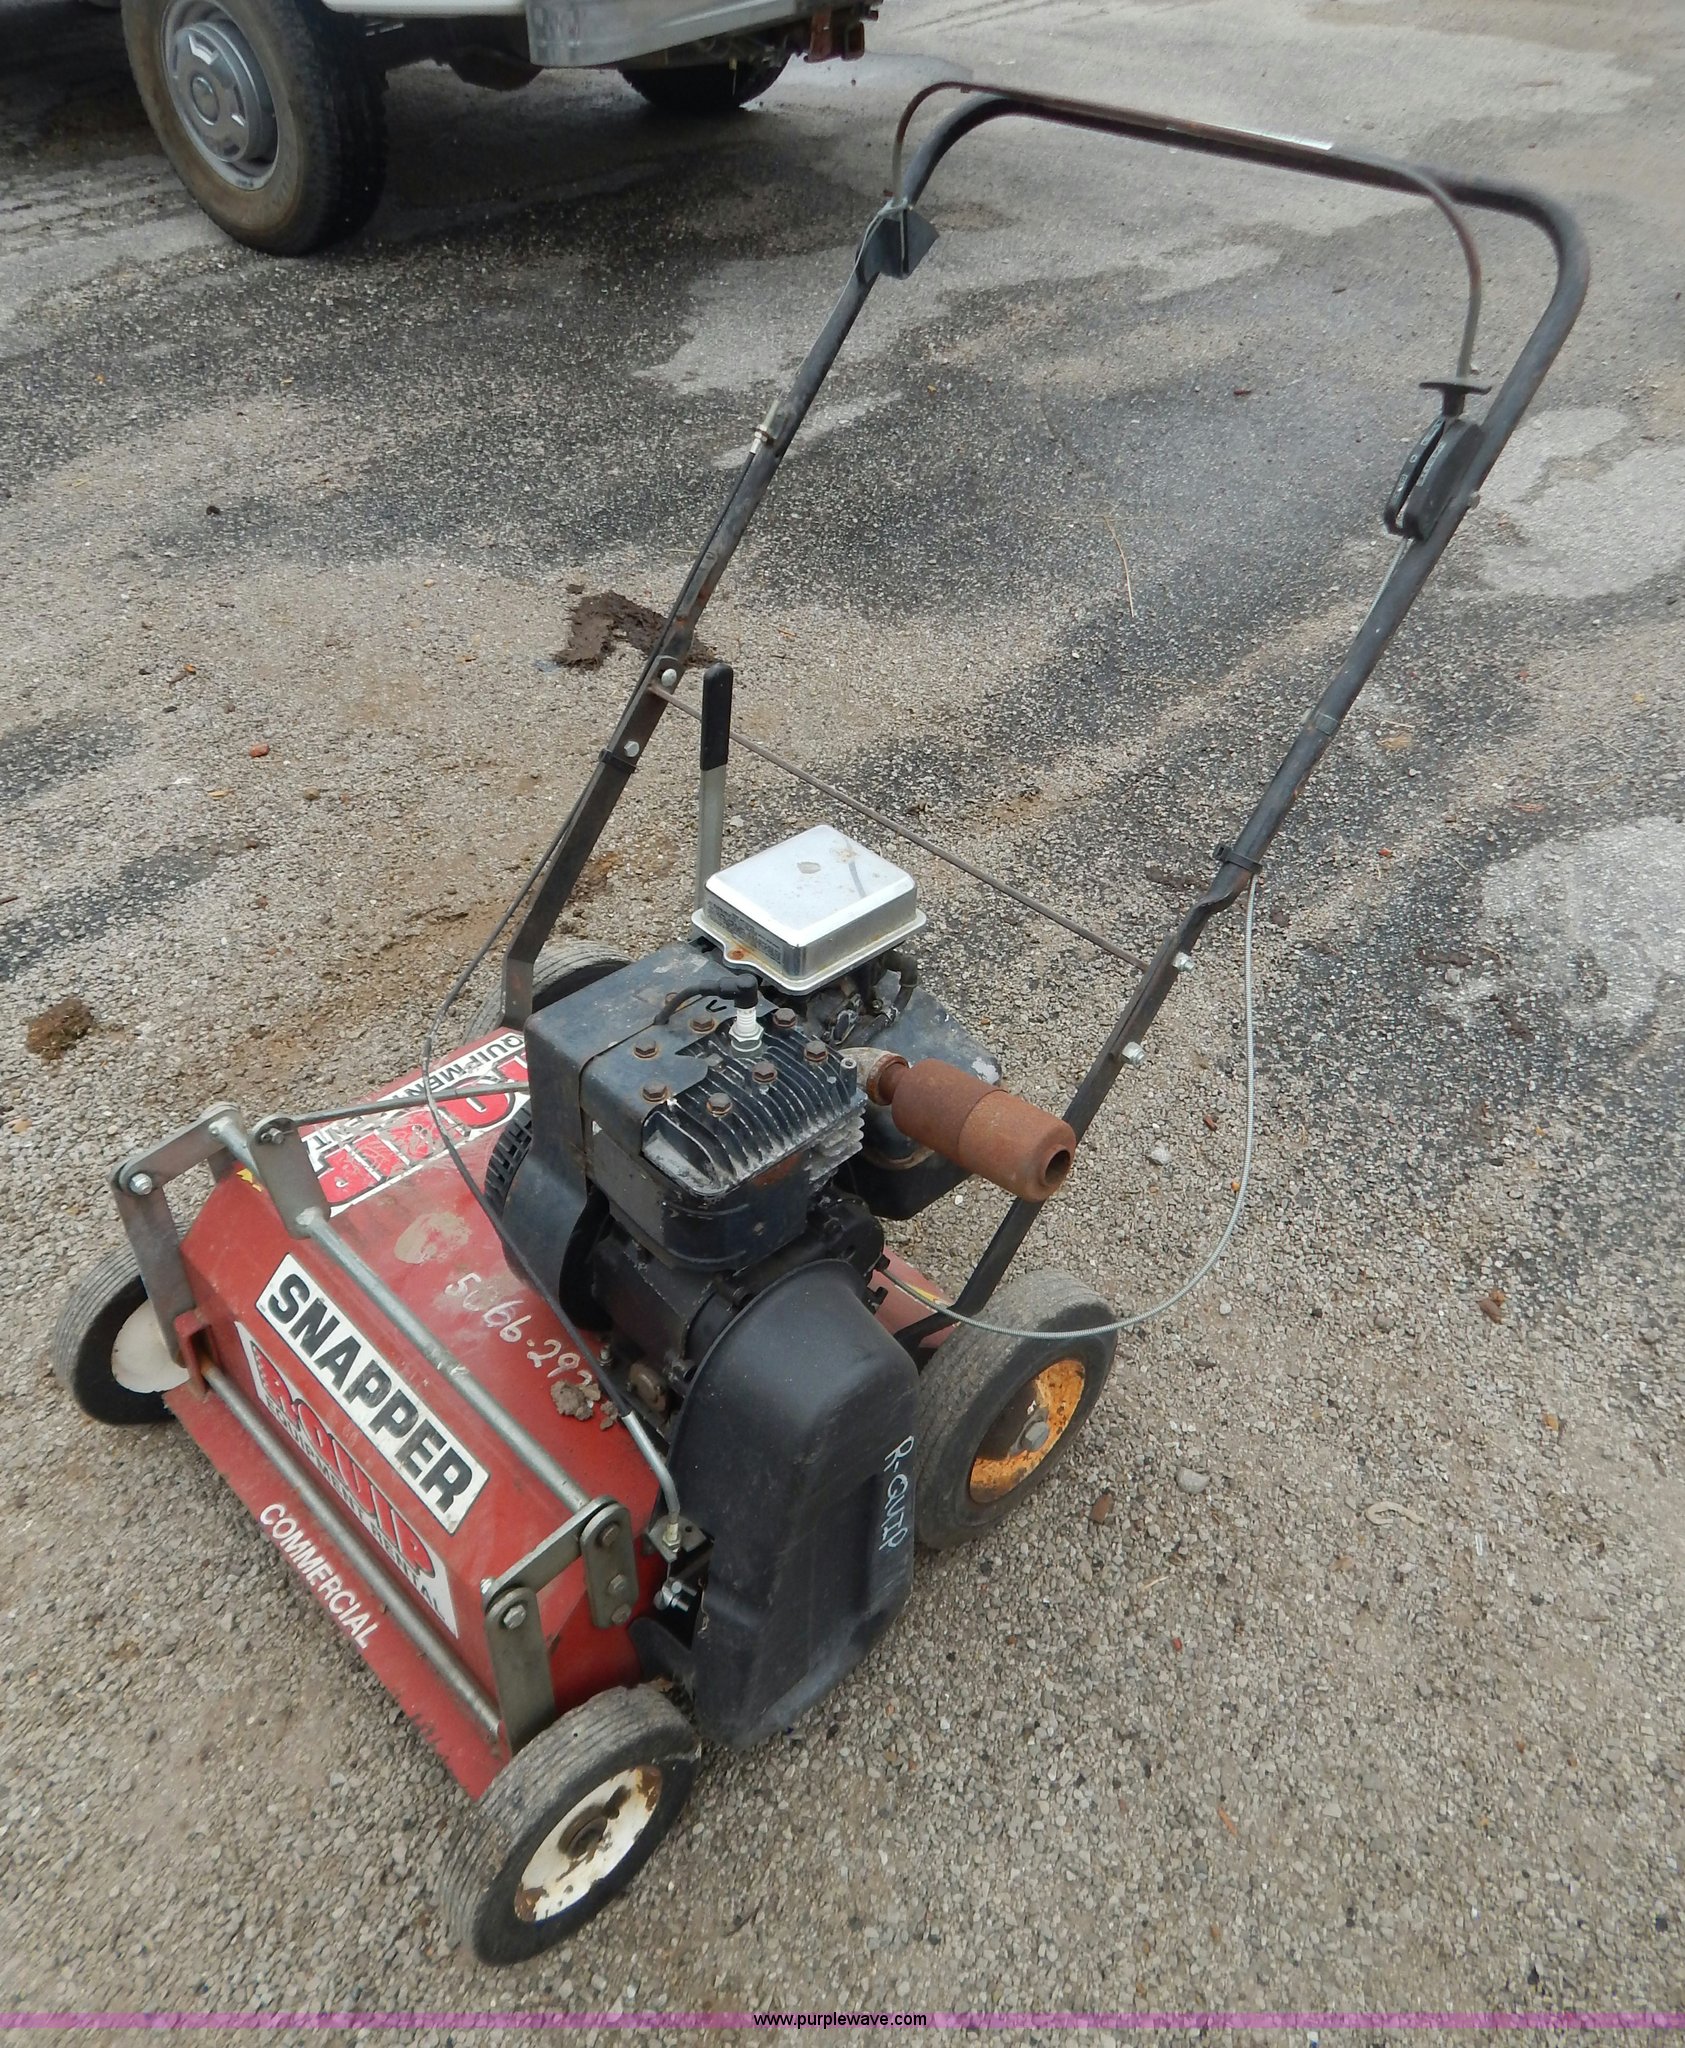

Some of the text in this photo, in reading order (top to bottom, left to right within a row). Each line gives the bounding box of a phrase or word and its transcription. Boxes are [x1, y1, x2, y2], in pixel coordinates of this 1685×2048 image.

[267, 1273, 473, 1514] SNAPPER
[259, 1503, 379, 1649] COMMERCIAL
[264, 1394, 446, 1622] EQUIPMENT RENTAL
